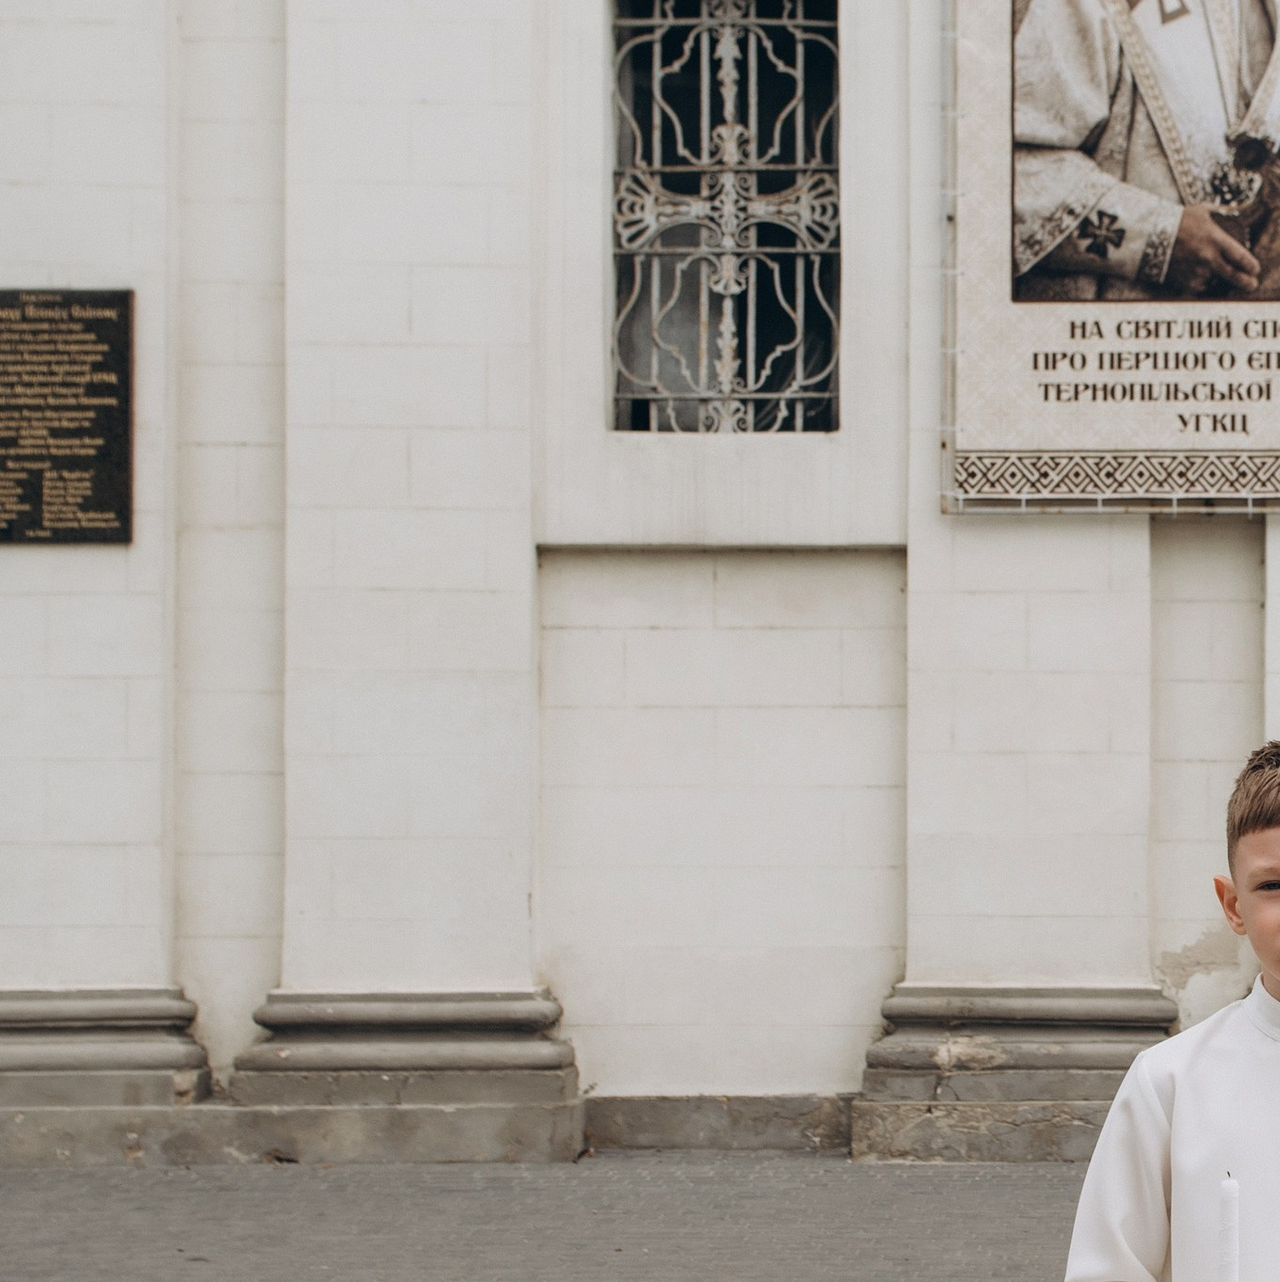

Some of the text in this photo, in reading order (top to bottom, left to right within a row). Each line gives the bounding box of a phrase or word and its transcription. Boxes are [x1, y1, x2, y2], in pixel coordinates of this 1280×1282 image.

[1069, 320, 1104, 340] НА
[1115, 315, 1233, 340] СВІТЛИЙ
[1032, 351, 1087, 371] ПРО
[1098, 351, 1236, 371] ПЕРШОГО
[1038, 377, 1272, 402] ТЕРНОПІЛЬСЬКОЇ
[1178, 413, 1249, 435] УГКЦ
